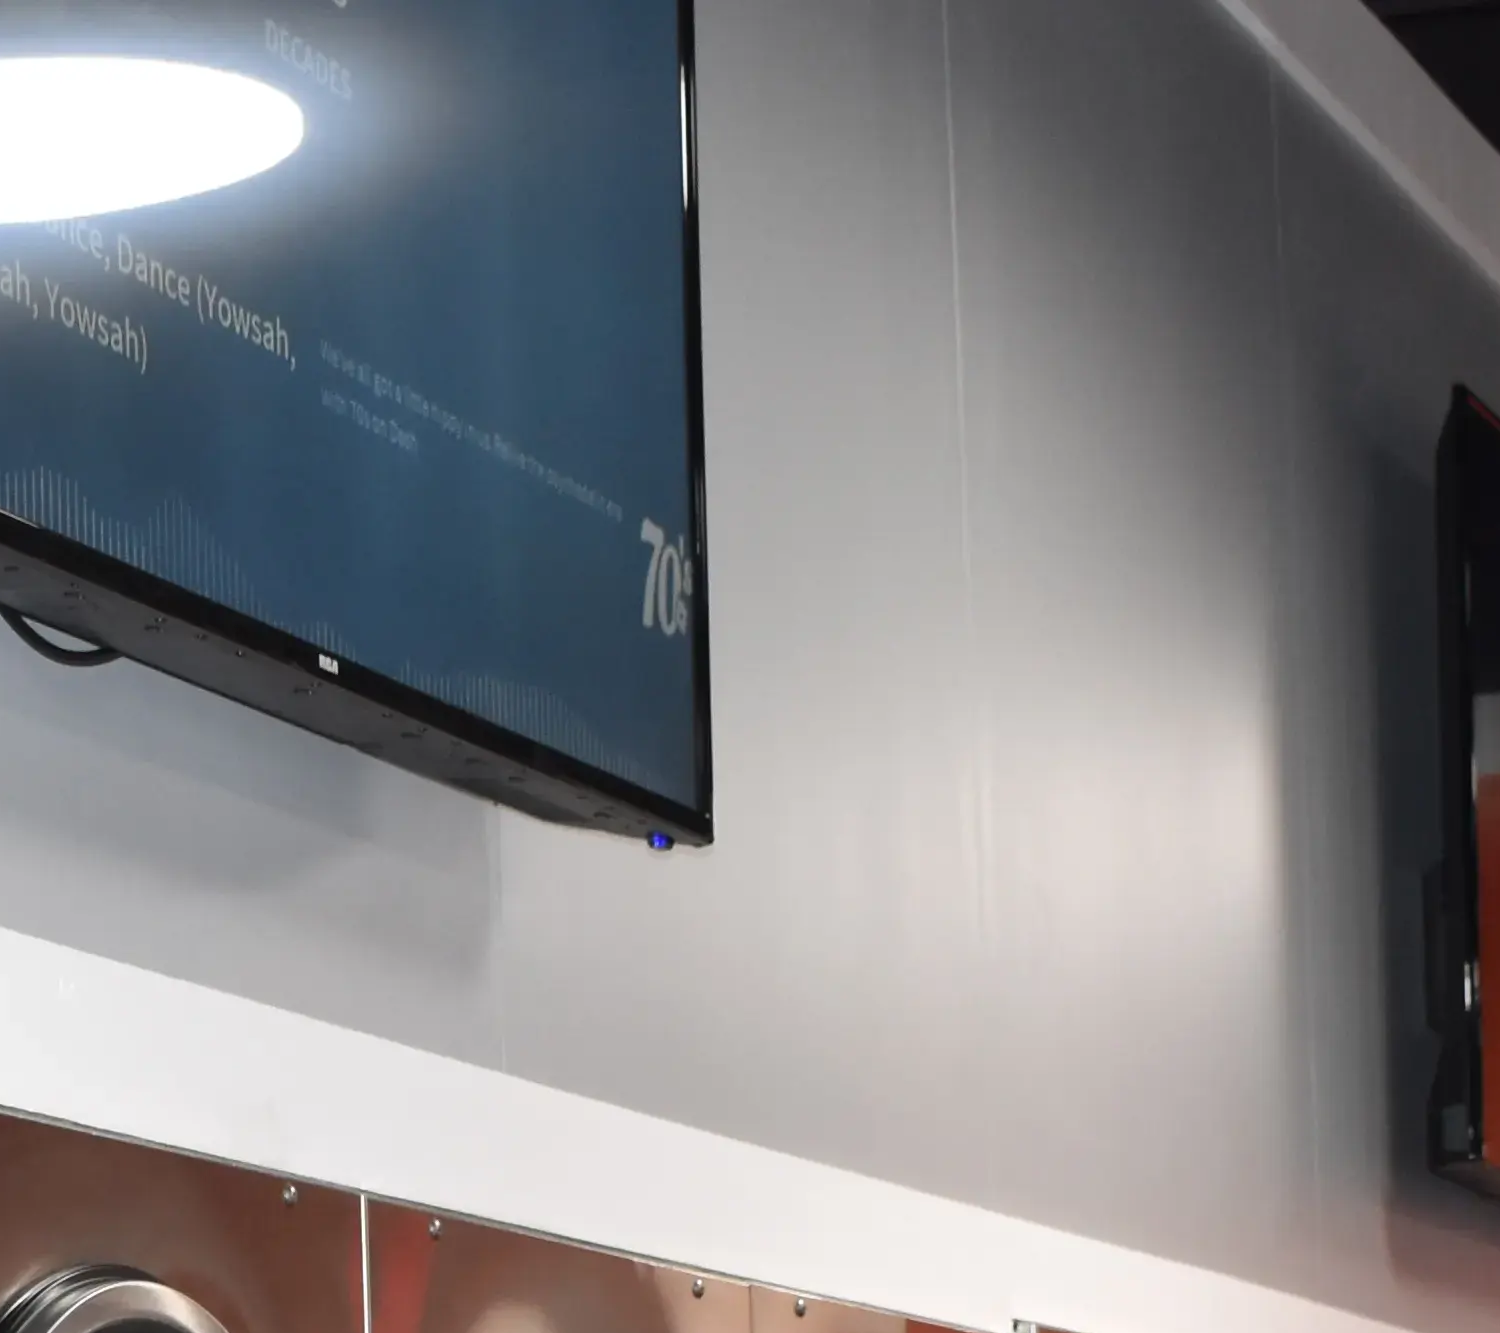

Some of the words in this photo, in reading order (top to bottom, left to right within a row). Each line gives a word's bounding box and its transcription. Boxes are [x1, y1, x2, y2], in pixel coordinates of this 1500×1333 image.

[265, 18, 351, 100] DECADES
[43, 277, 148, 374] Yowsah)
[118, 233, 191, 305] Dance
[197, 275, 296, 371] (Yowsah,
